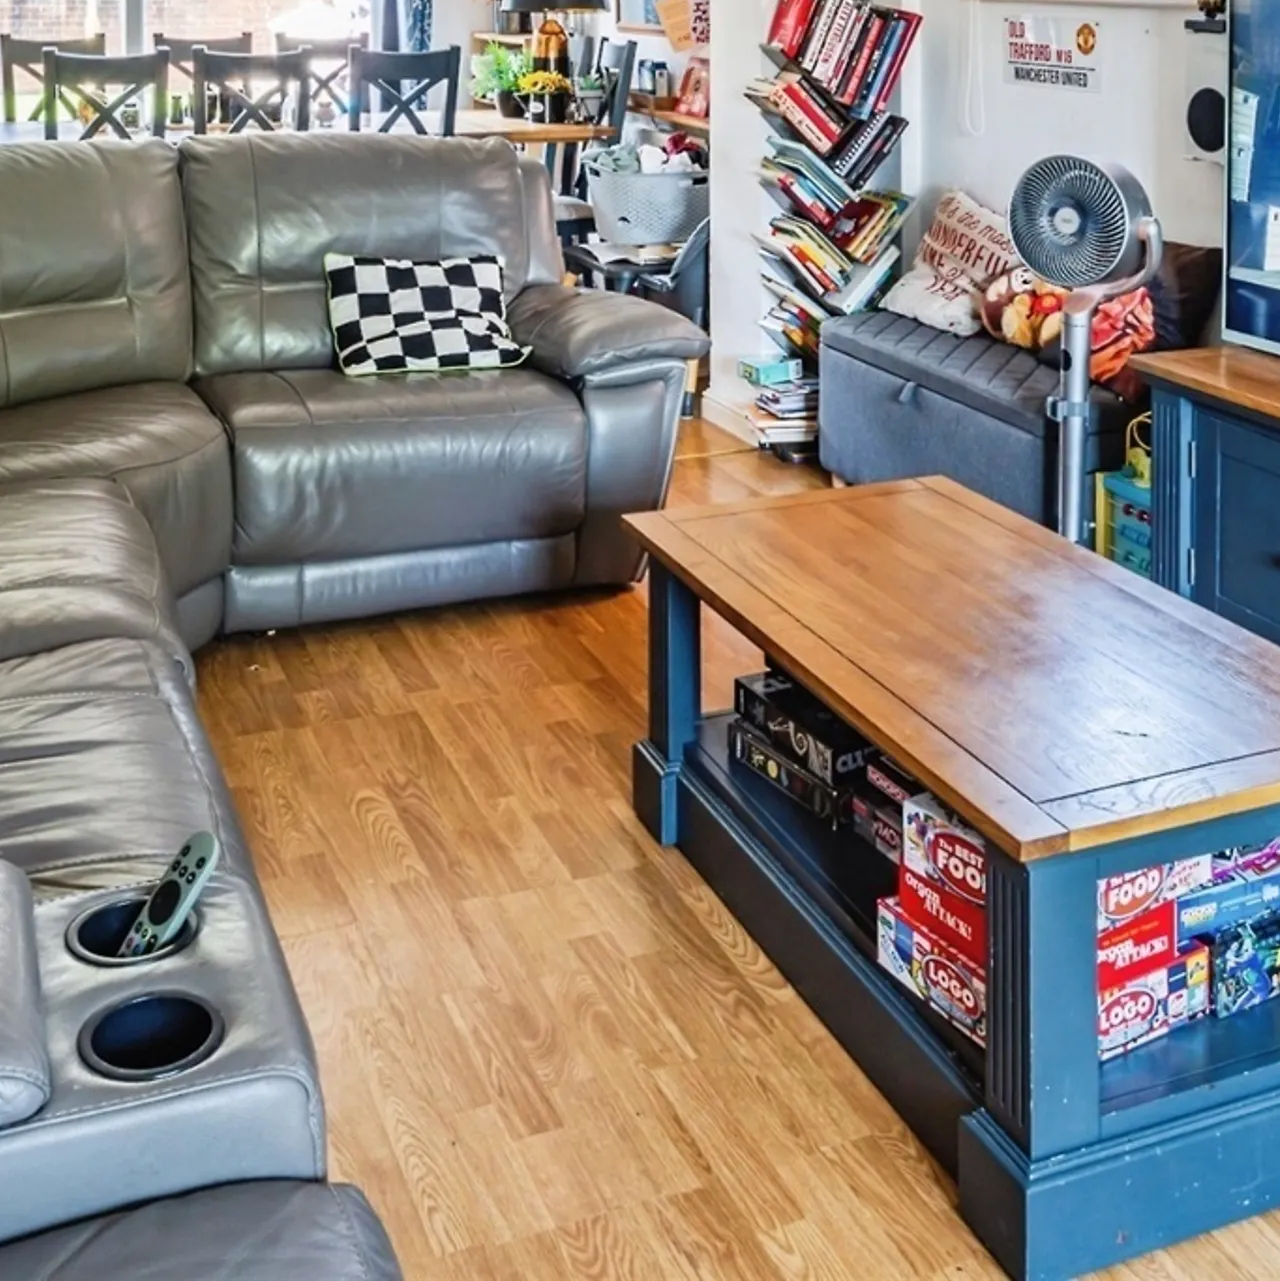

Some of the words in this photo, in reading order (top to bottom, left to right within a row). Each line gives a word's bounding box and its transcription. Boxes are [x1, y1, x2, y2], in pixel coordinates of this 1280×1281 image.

[1008, 20, 1026, 39] OLD
[1008, 41, 1052, 62] TRAFFORD
[1014, 66, 1060, 85] MANCHESTER
[1061, 71, 1088, 88] UNITED
[954, 844, 985, 870] BEST
[1107, 868, 1161, 913] FOOD
[922, 894, 972, 942] ATTACK!
[928, 961, 975, 1009] LOGO
[1099, 994, 1151, 1032] LOGO
